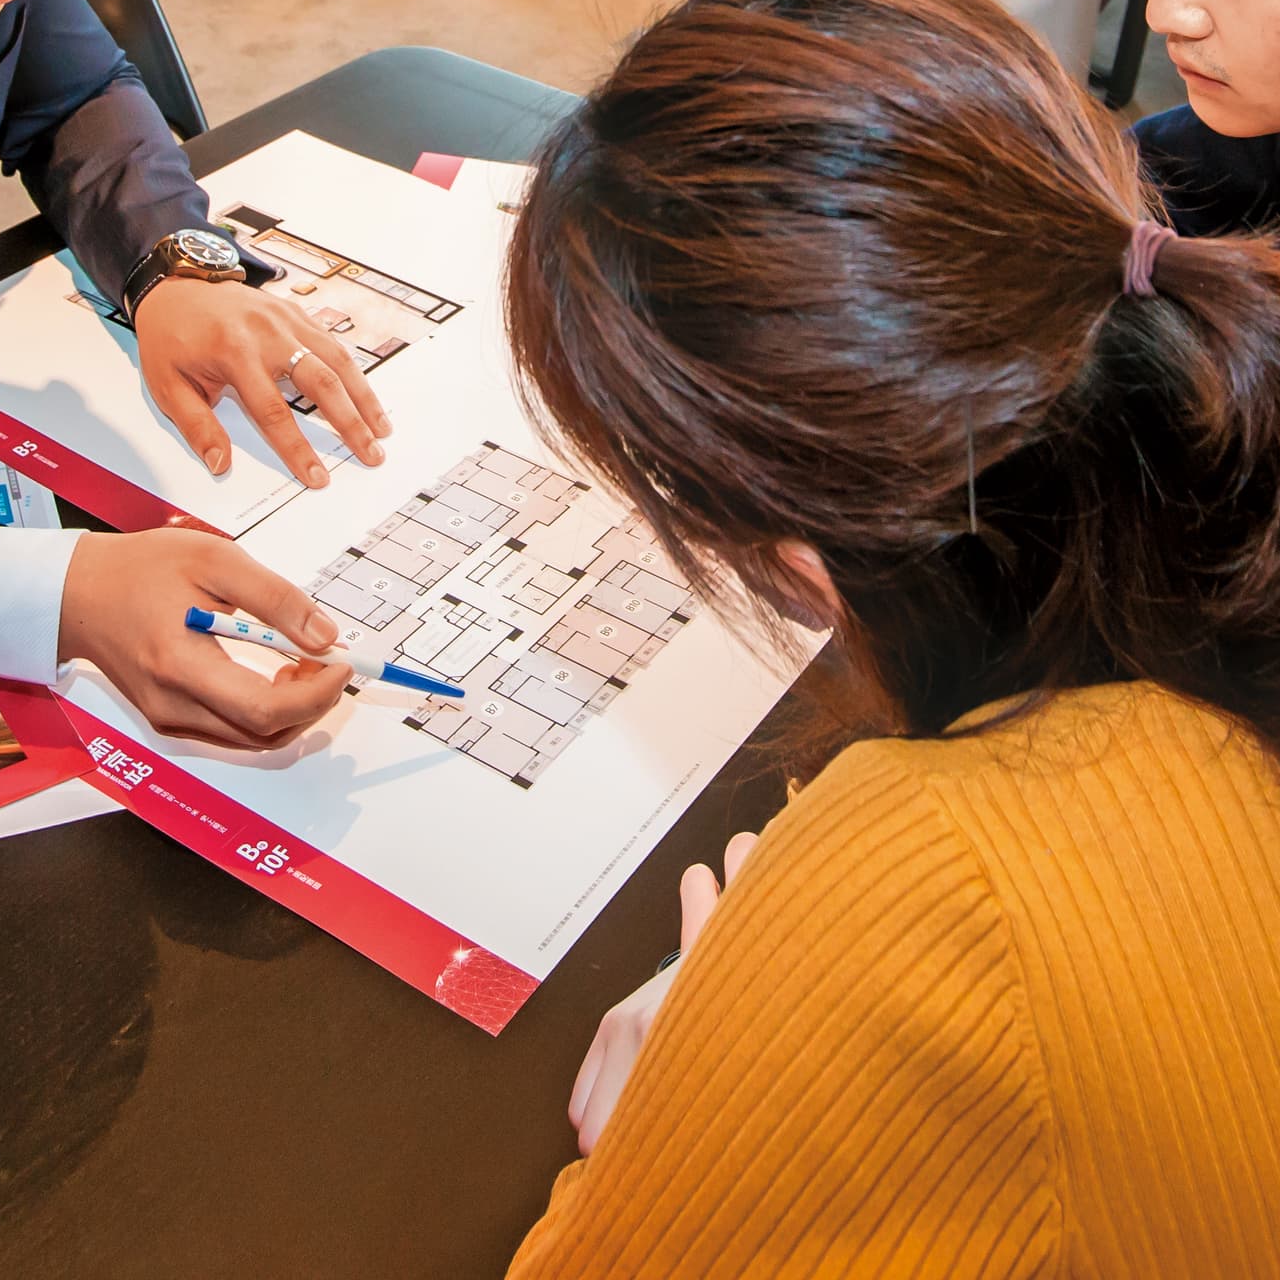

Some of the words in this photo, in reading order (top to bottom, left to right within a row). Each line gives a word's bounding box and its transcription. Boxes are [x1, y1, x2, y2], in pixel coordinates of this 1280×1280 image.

[13, 440, 38, 457] B5
[423, 540, 436, 550] B3
[375, 579, 389, 590] B5
[625, 599, 641, 611] B10
[346, 630, 360, 642] B6
[599, 626, 613, 636] B9
[555, 670, 569, 682] B8
[485, 704, 499, 715] B7
[87, 737, 153, 785] 新京站
[256, 844, 291, 876] 10F
